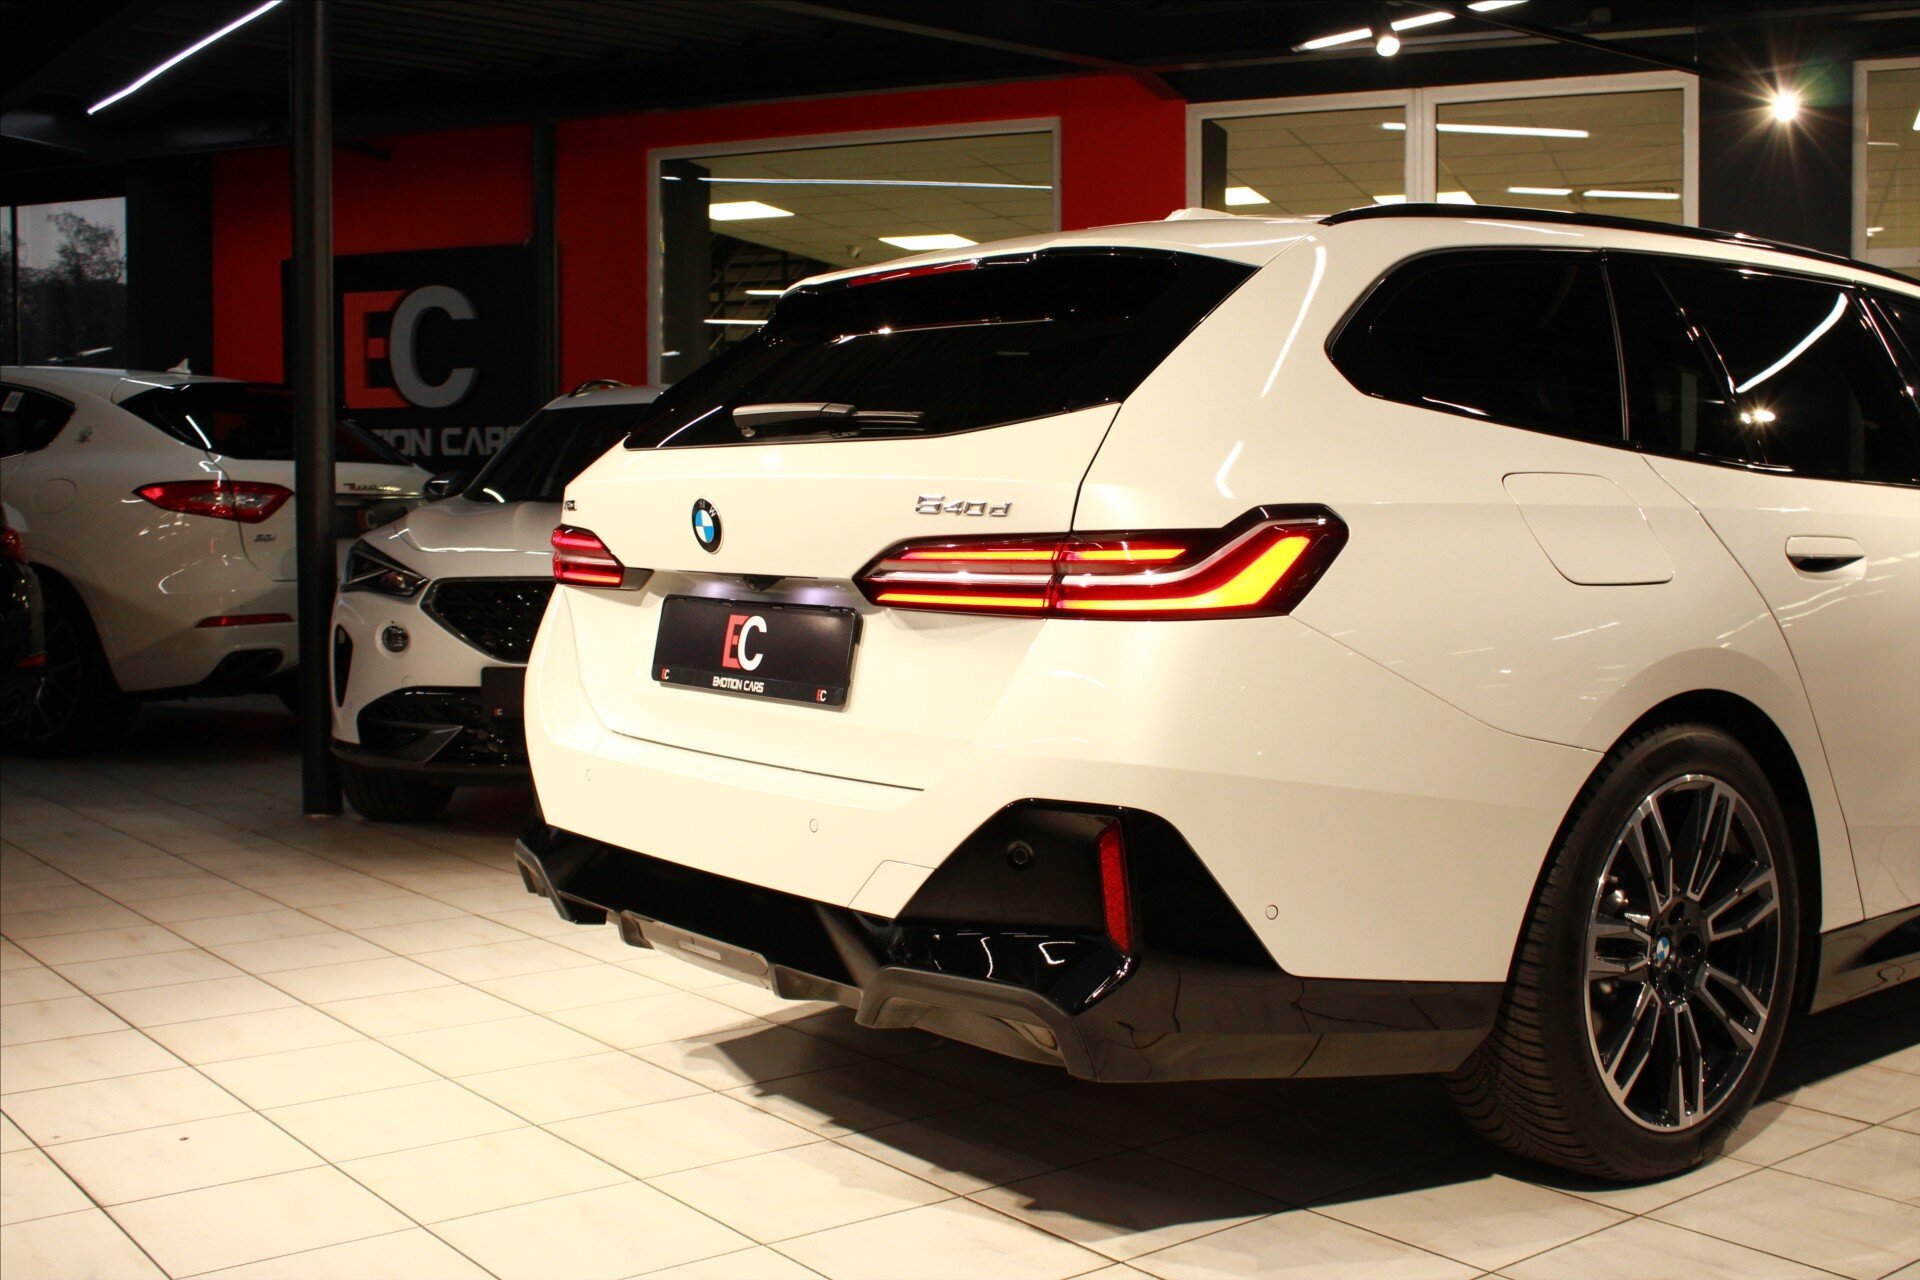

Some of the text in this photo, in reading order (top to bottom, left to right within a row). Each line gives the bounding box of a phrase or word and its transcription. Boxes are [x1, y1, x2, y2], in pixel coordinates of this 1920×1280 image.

[343, 285, 478, 410] EC
[915, 494, 1012, 517] 540d
[722, 614, 768, 671] EC
[743, 680, 765, 694] CARS
